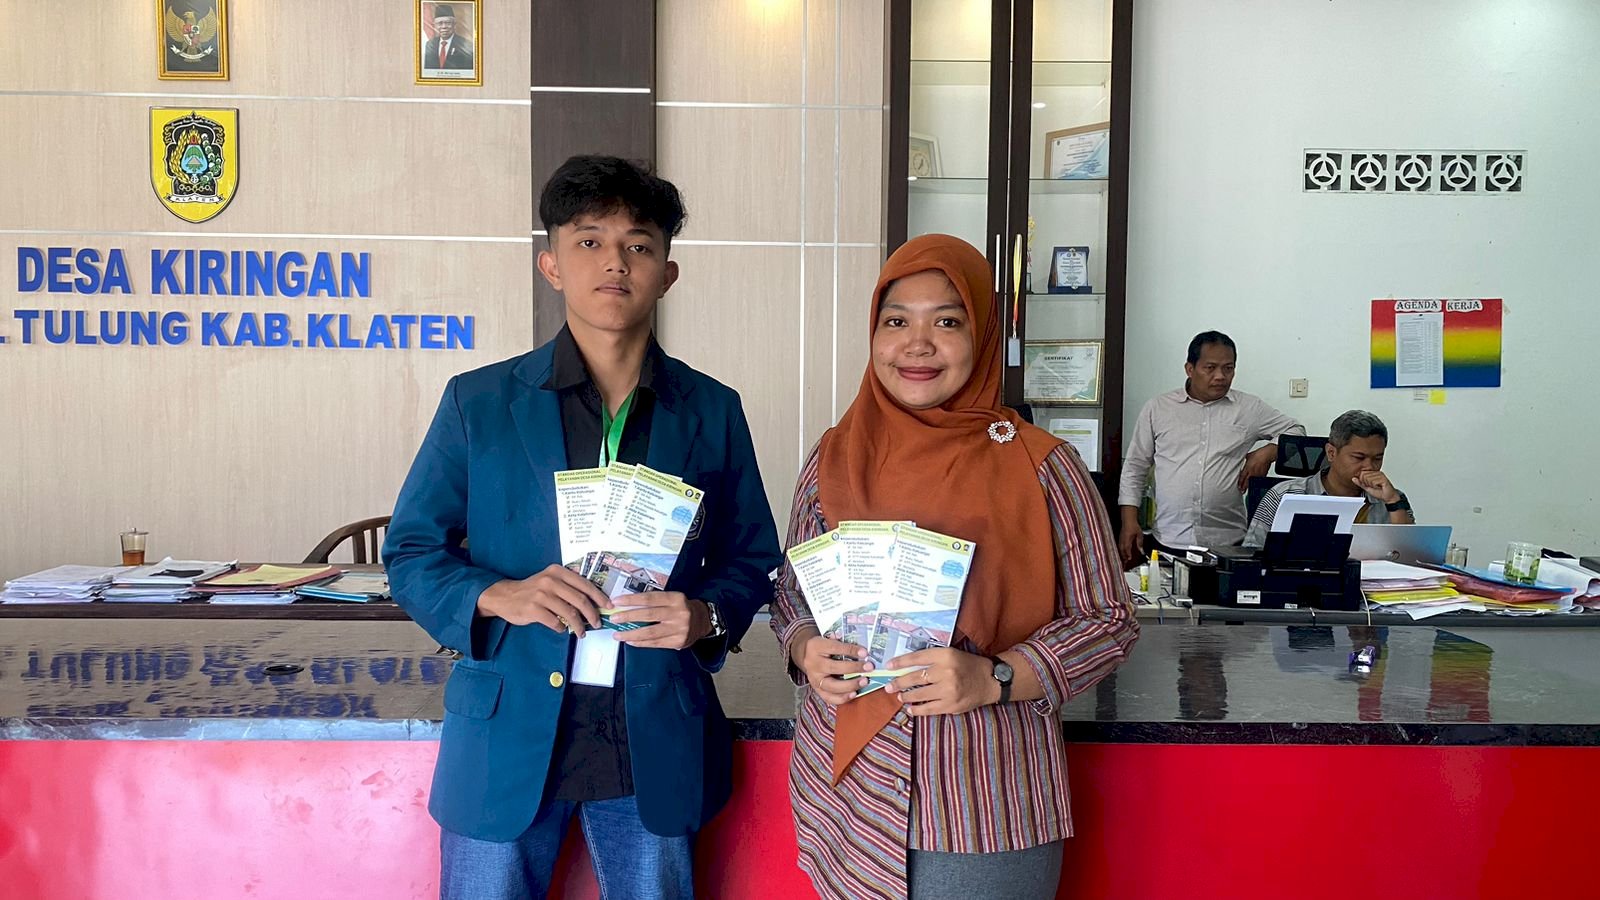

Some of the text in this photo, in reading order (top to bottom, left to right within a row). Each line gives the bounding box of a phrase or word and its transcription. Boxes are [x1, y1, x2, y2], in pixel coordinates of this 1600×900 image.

[17, 247, 371, 297] DESA KIRINGAN
[1396, 301, 1480, 310] AGENDA KERJA
[14, 309, 190, 345] TULUNG
